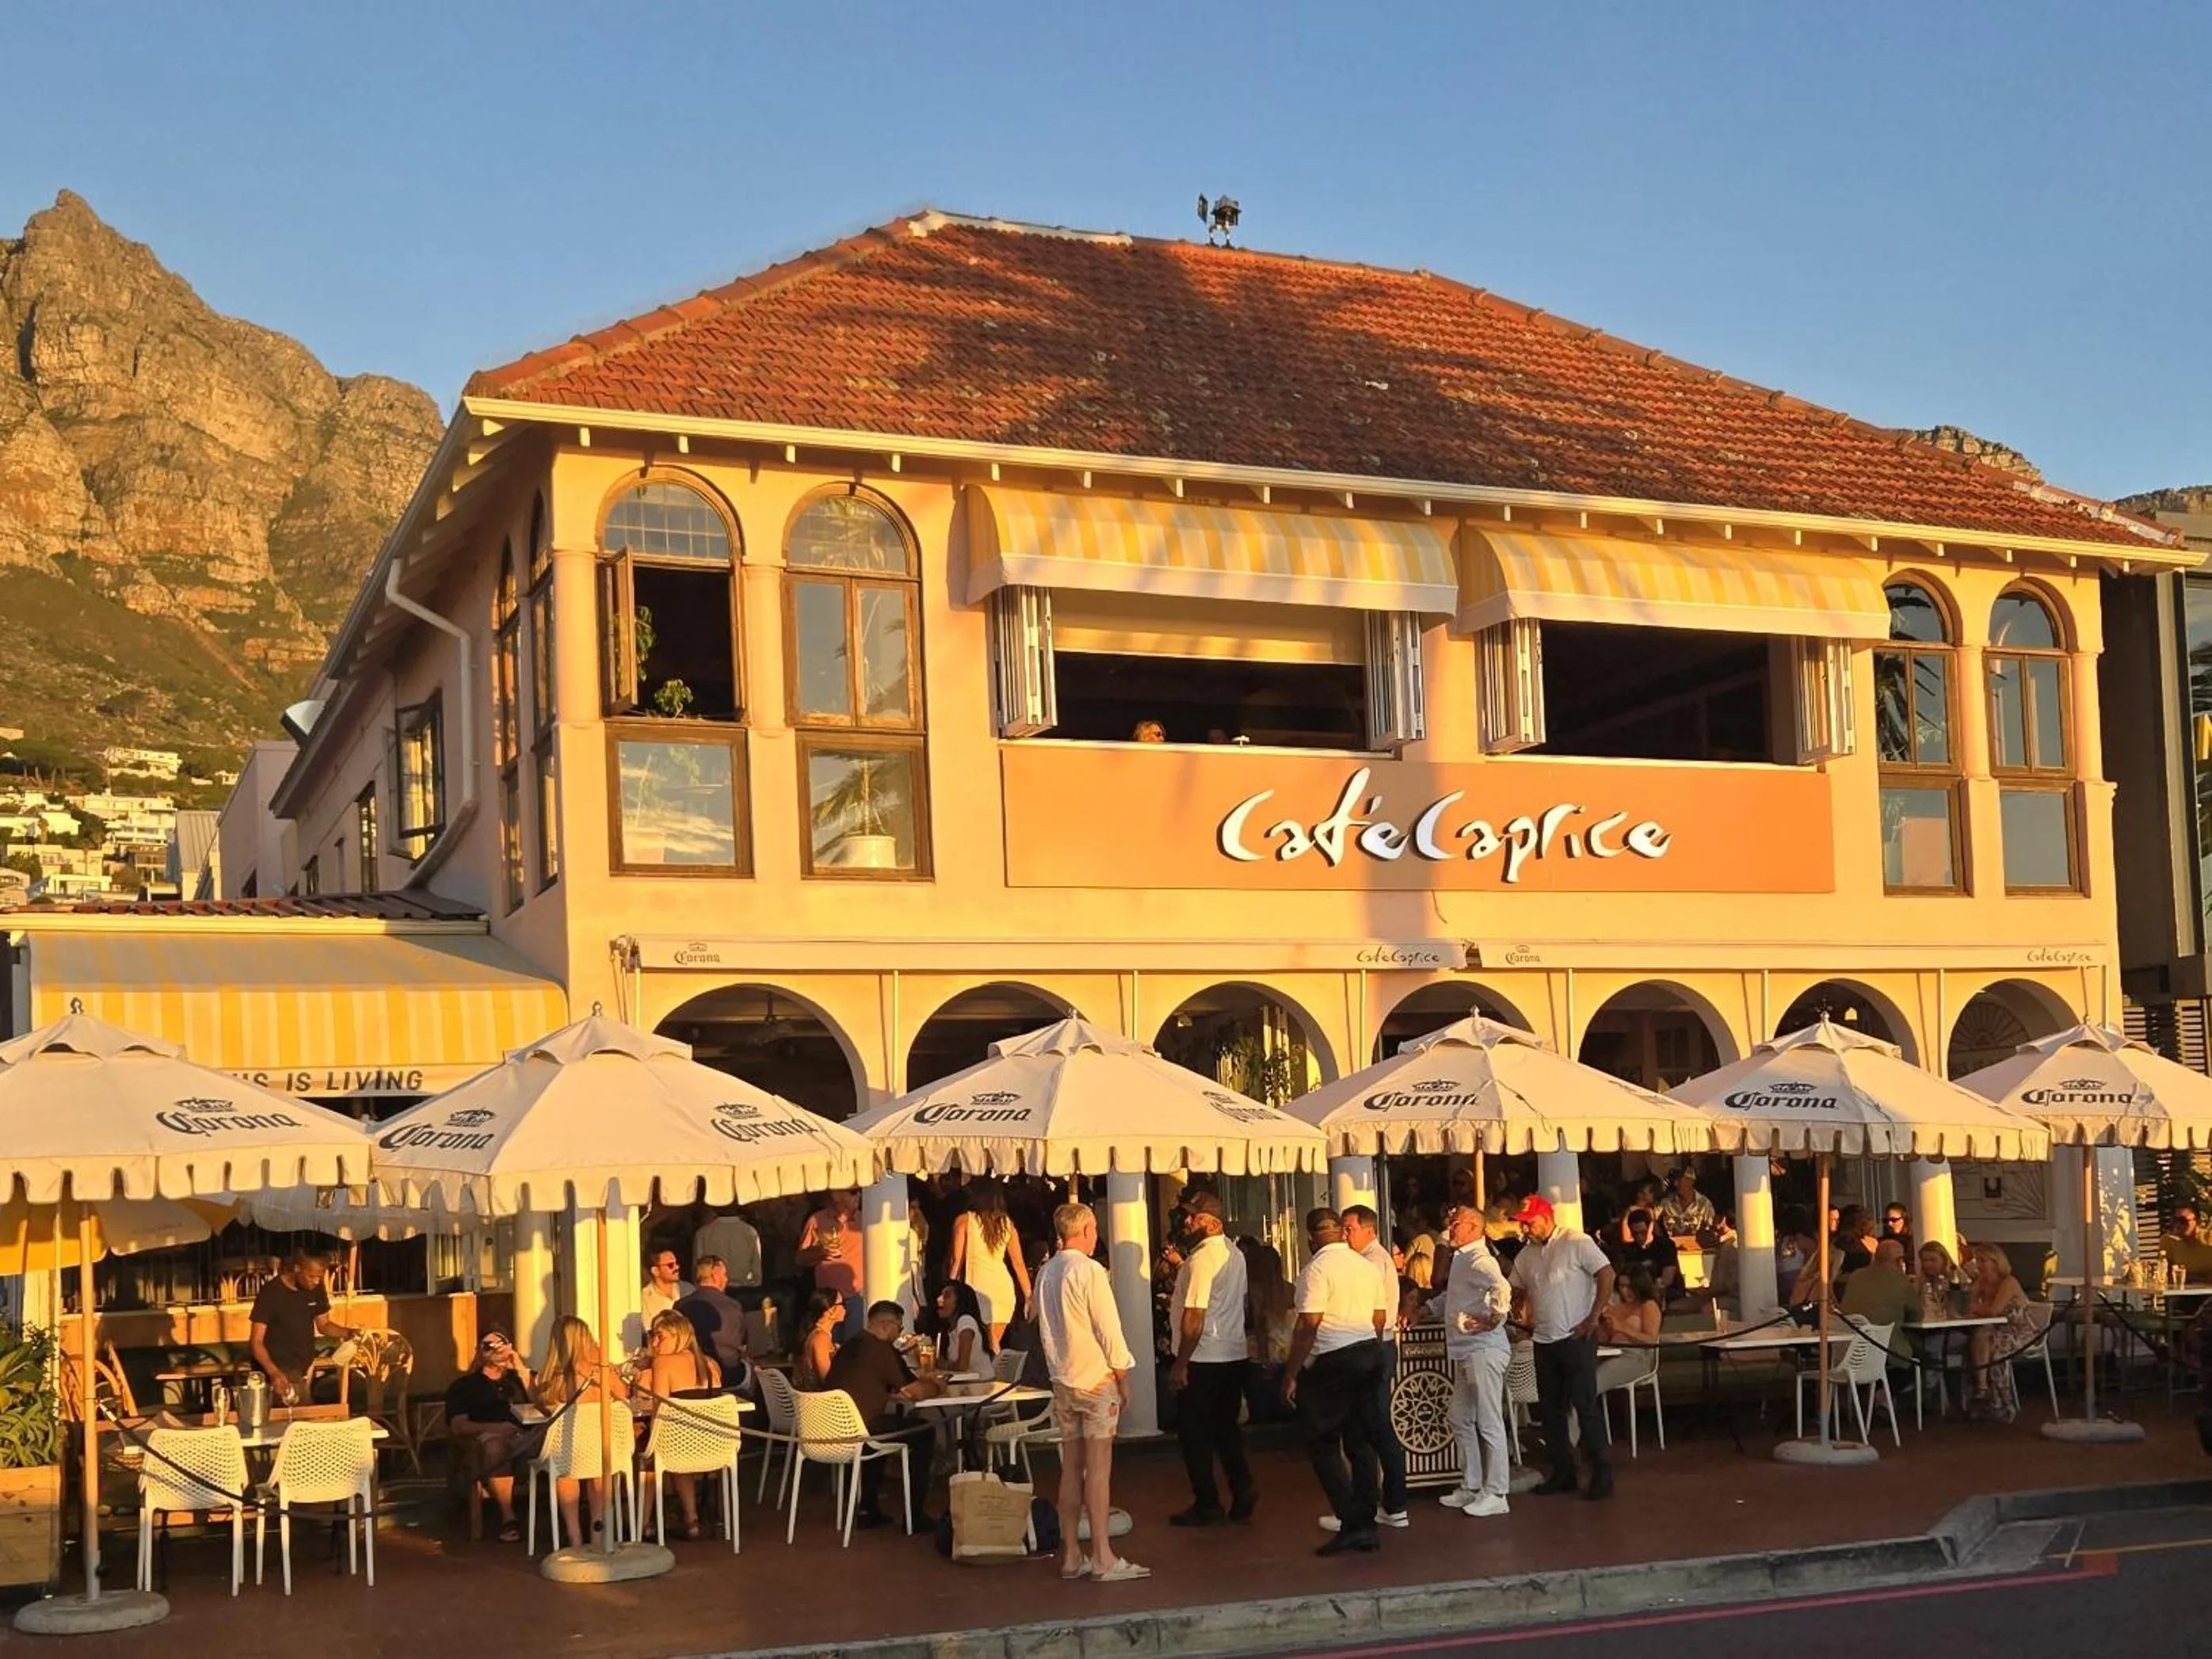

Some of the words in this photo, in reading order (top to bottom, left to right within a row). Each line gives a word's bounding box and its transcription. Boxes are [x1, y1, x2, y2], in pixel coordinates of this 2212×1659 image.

[1410, 790, 1672, 883] Caprice
[673, 951, 721, 965] Corona
[1505, 951, 1541, 965] Corona
[285, 1073, 311, 1092] IS
[326, 1070, 424, 1091] LIVING
[1363, 1091, 1478, 1112] Corona
[1725, 1090, 1838, 1110] Corona
[2021, 1089, 2133, 1106] Corona
[156, 1111, 303, 1137] Corona
[913, 1103, 1032, 1126] Corona
[379, 1122, 495, 1151] Corona
[711, 1117, 818, 1145] Corona
